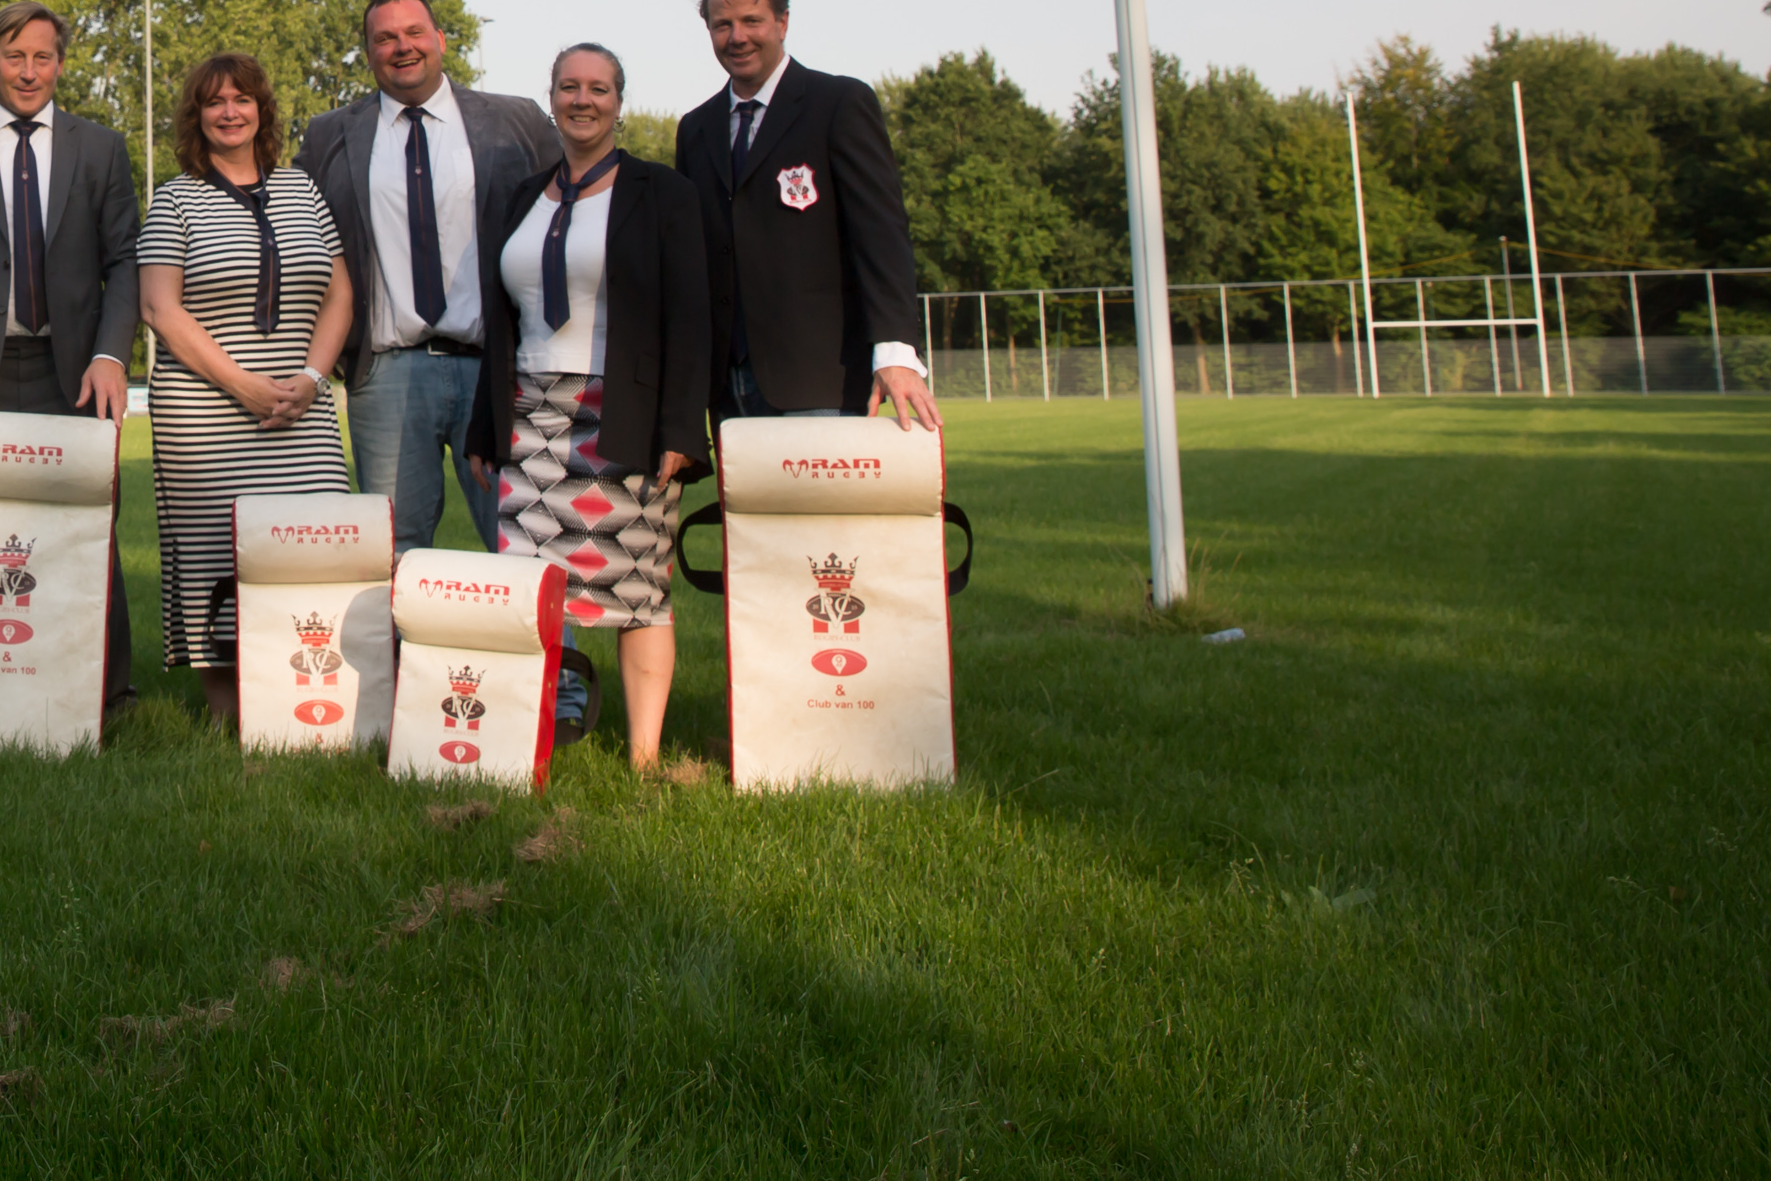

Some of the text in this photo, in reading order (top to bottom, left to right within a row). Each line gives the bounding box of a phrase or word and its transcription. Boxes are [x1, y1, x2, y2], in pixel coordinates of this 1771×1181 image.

[2, 444, 63, 457] RAM
[1, 455, 63, 466] RUGBY
[811, 458, 880, 469] RAM
[811, 471, 881, 479] RUGBY
[297, 524, 358, 535] RAM
[296, 536, 359, 544] RUGBY
[445, 580, 510, 596] RAM
[444, 592, 509, 606] RUGBY
[2, 651, 12, 662] &
[1, 666, 17, 674] van
[21, 666, 36, 675] 100
[835, 684, 846, 696] &
[807, 699, 875, 710] Club van 100
